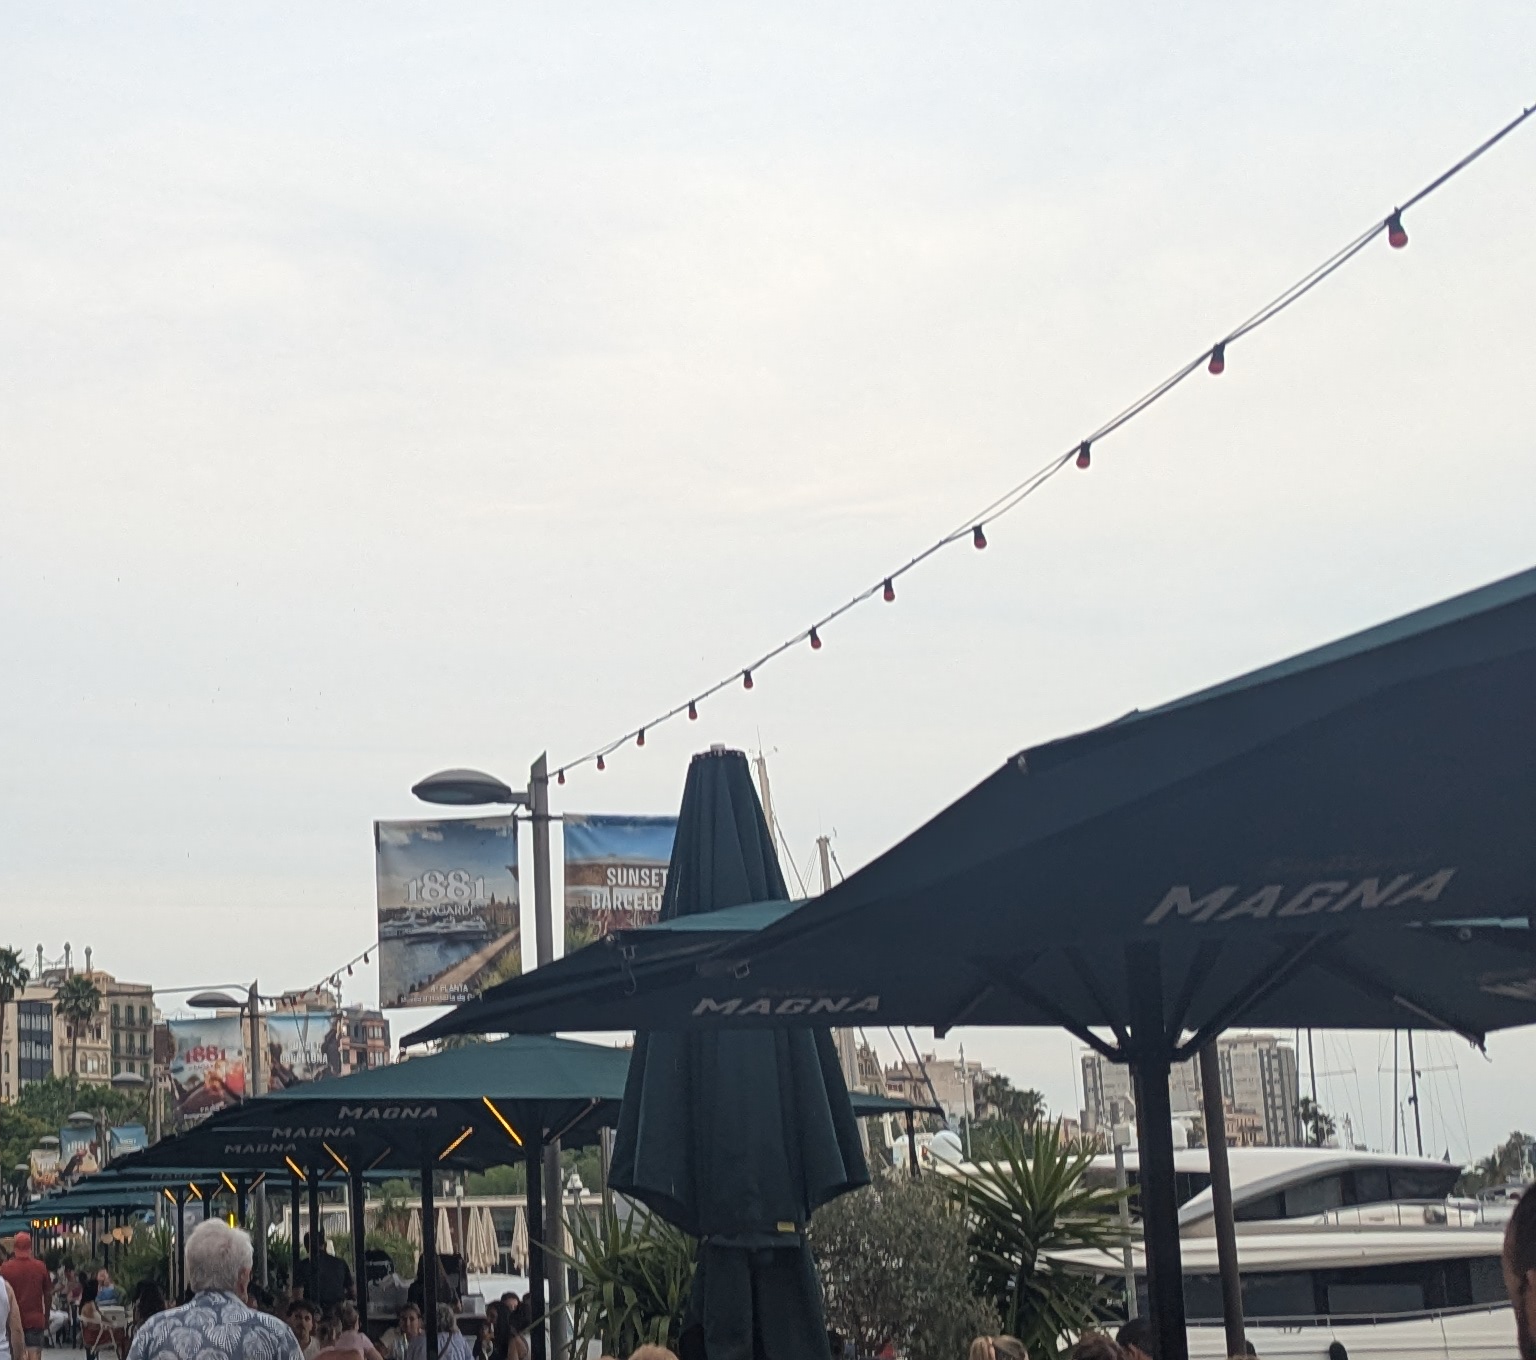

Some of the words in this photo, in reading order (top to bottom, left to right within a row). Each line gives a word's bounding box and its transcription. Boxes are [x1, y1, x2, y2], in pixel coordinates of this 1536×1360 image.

[404, 869, 490, 903] 1881
[606, 867, 669, 887] SUNSET
[591, 892, 662, 911] BARCELO
[1144, 867, 1458, 925] MAGNA
[692, 996, 880, 1016] MAGNA
[186, 1045, 226, 1064] 1881
[338, 1105, 438, 1120] MAGNA
[272, 1126, 356, 1139] MAGNA
